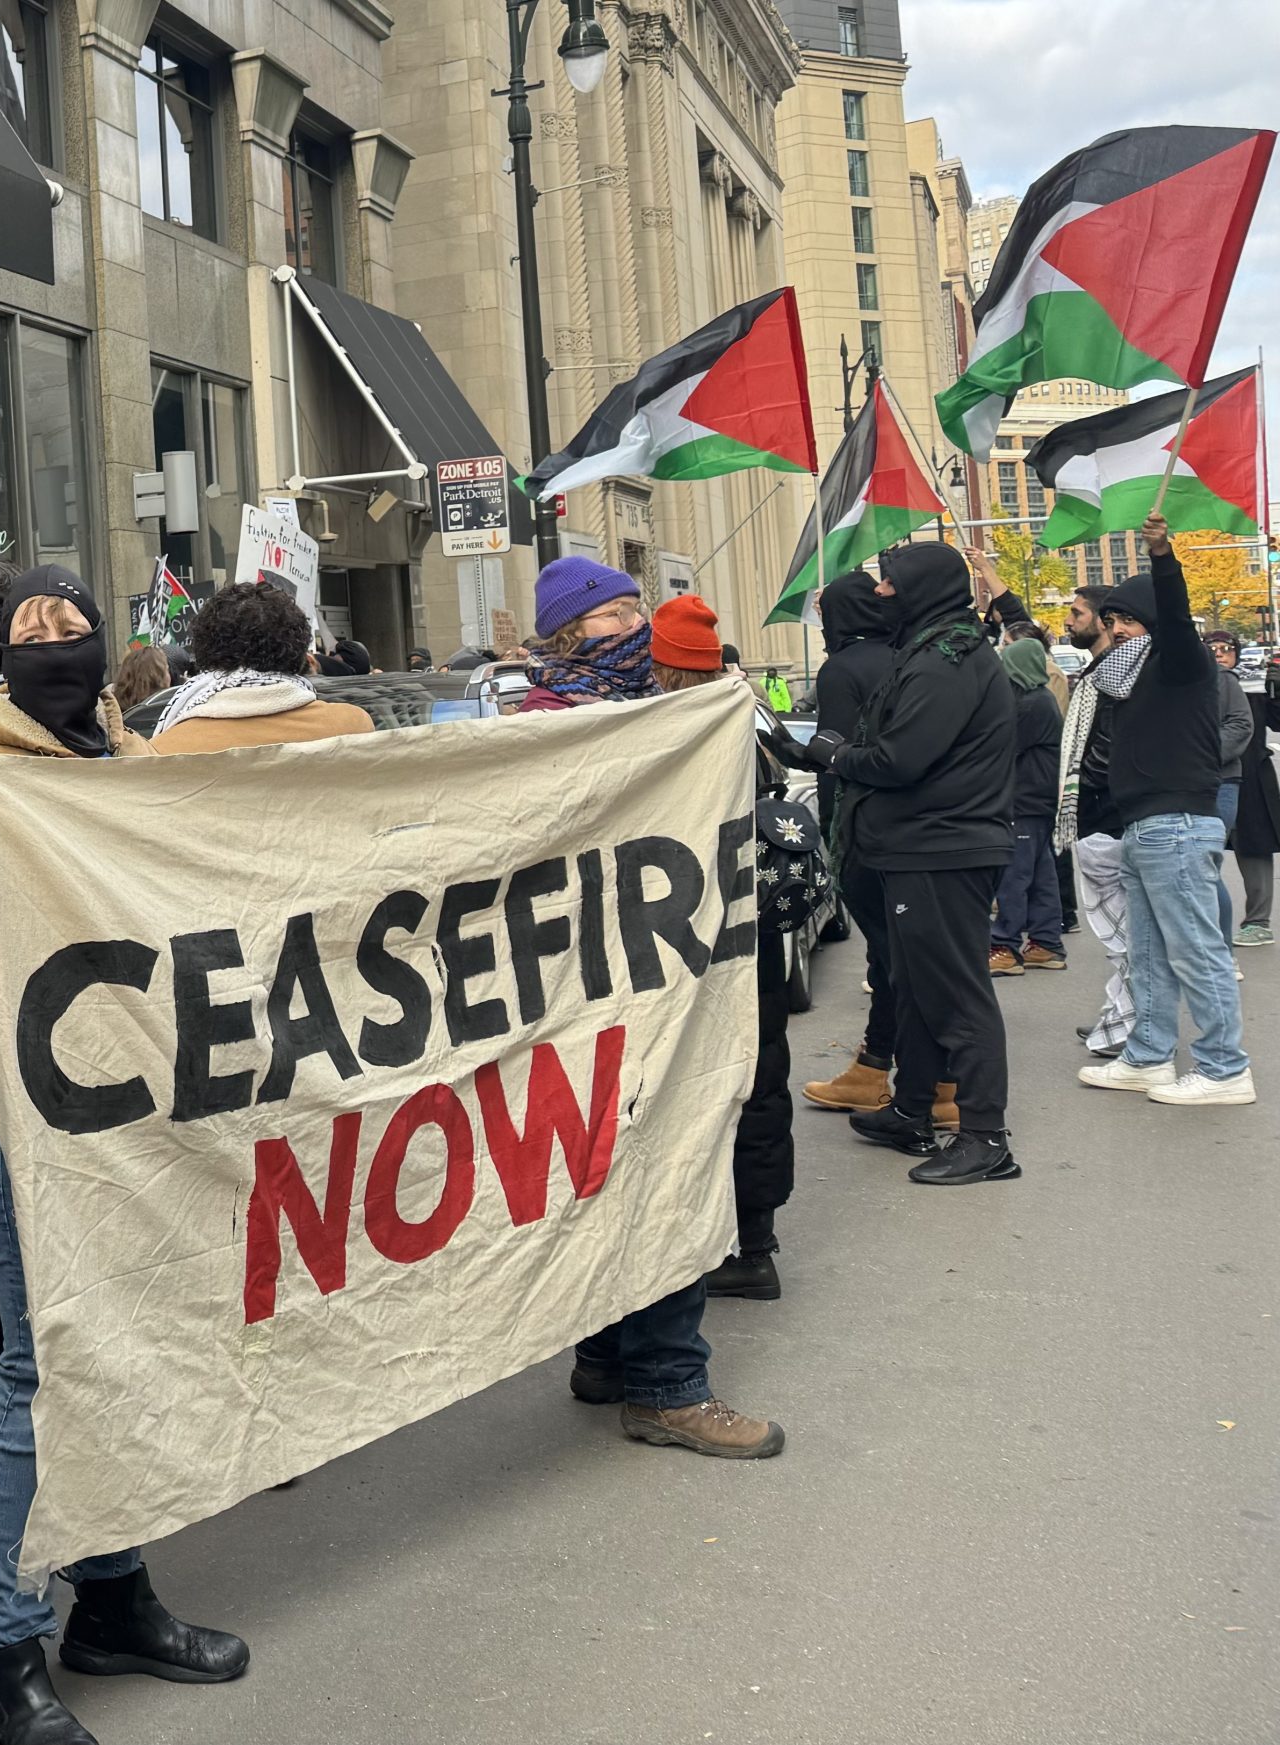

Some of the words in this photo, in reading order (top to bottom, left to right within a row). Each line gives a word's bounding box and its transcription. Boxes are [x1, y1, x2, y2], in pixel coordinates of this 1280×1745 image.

[440, 462, 474, 479] ZONE
[475, 460, 502, 476] 105
[262, 540, 288, 570] NOT
[466, 541, 484, 549] HERE
[15, 811, 756, 1134] CEASEFIRE
[244, 1026, 626, 1325] NOW
